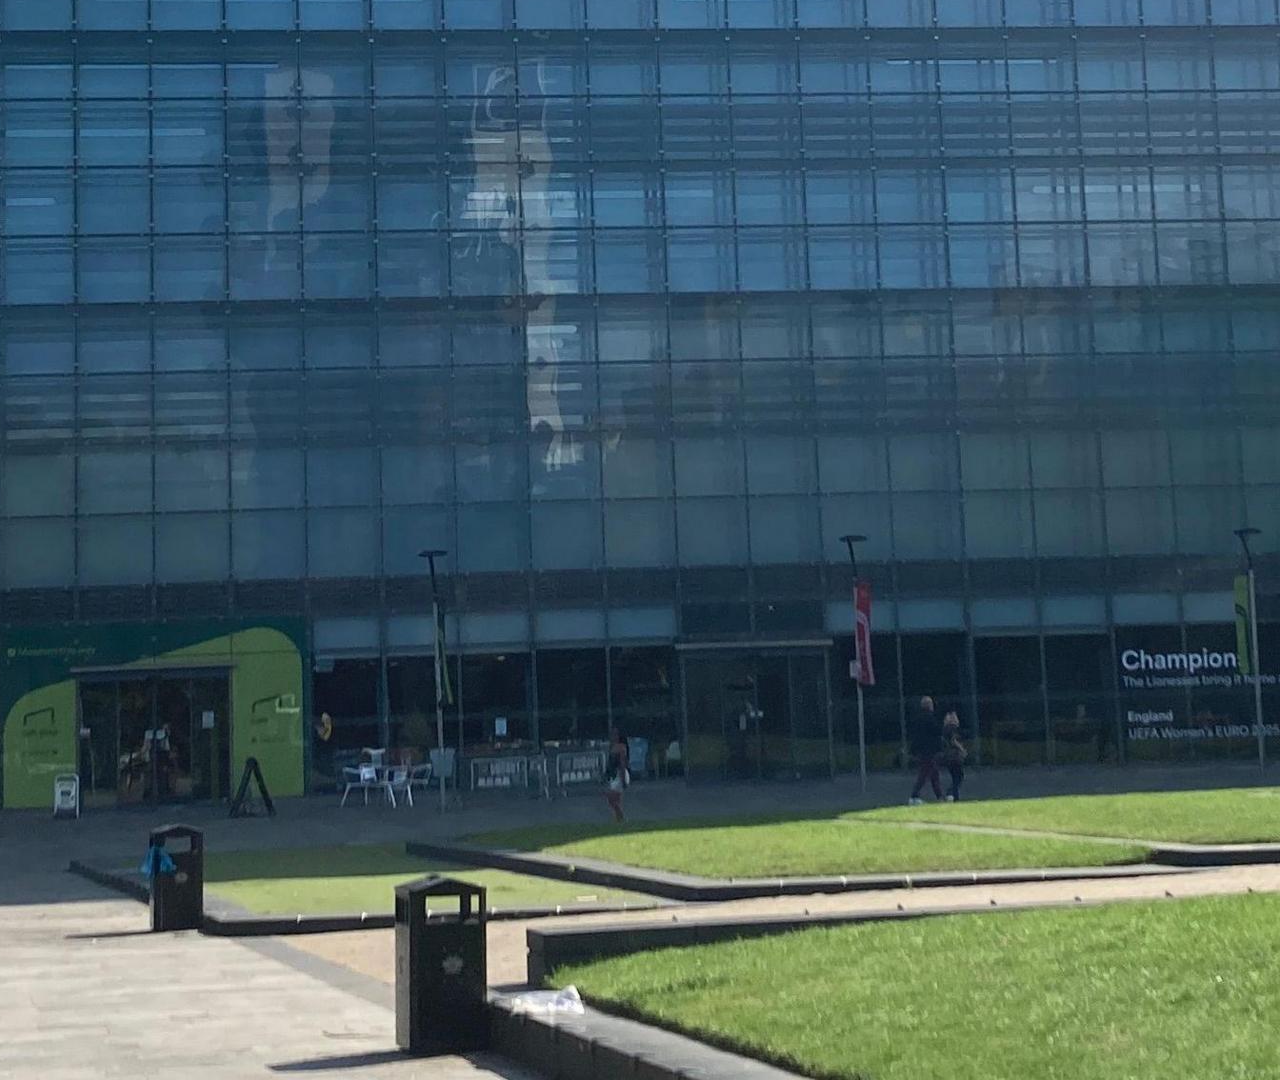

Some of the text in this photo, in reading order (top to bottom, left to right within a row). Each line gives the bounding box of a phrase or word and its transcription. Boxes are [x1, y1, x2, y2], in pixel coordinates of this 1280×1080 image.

[1122, 648, 1240, 673] Champion
[1127, 709, 1173, 723] England
[1128, 726, 1159, 740] UEFA
[1161, 725, 1214, 739] Women's
[1216, 724, 1249, 738] EURO
